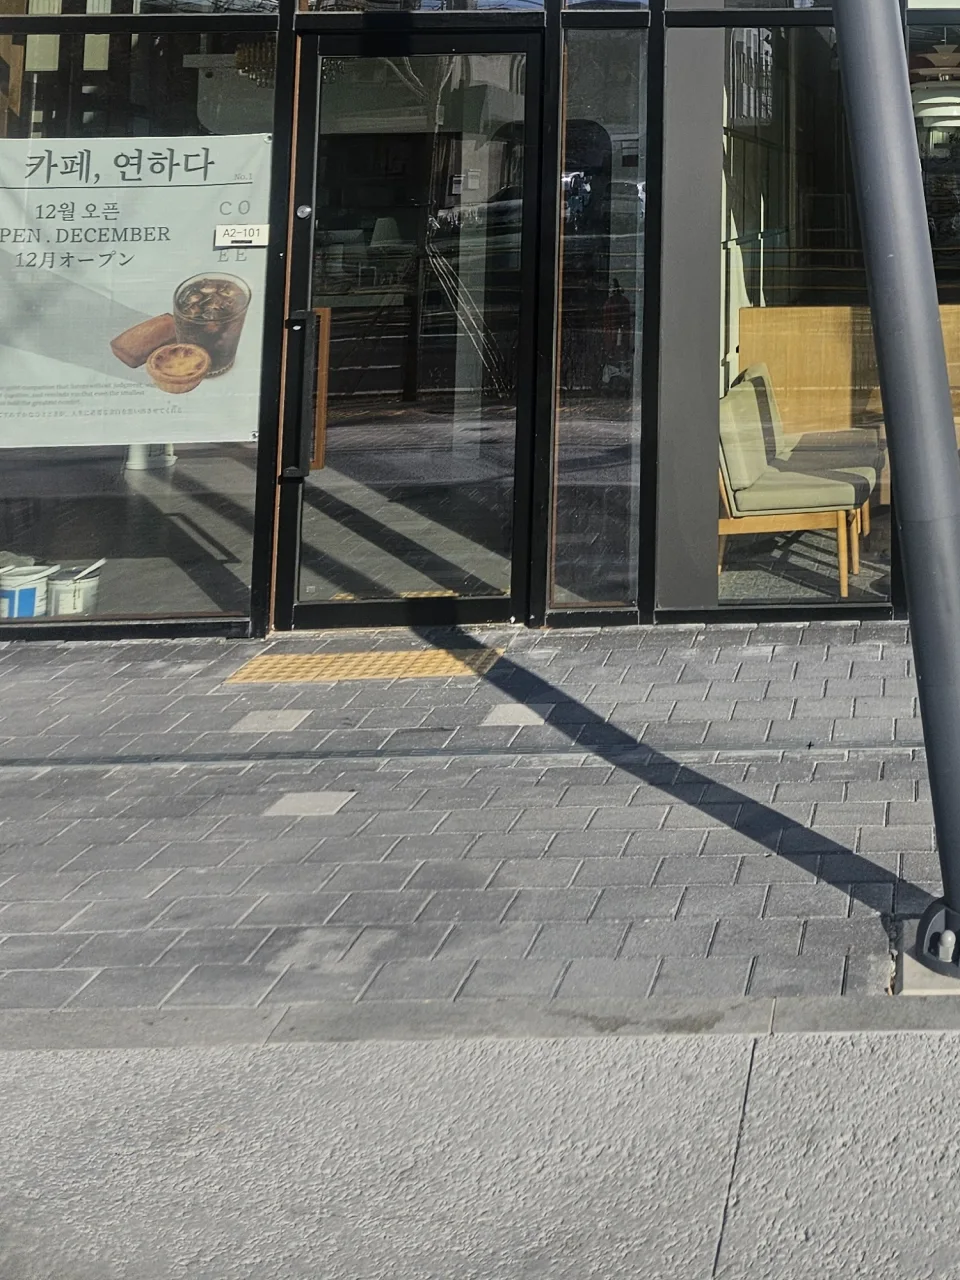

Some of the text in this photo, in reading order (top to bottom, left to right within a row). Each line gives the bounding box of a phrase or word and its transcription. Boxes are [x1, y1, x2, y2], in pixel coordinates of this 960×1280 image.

[114, 147, 215, 182] 연하다
[35, 201, 120, 222] 12월 오픈
[55, 226, 172, 243] DECEMBER
[222, 228, 260, 238] A2-101
[15, 250, 136, 269] 12月オープン
